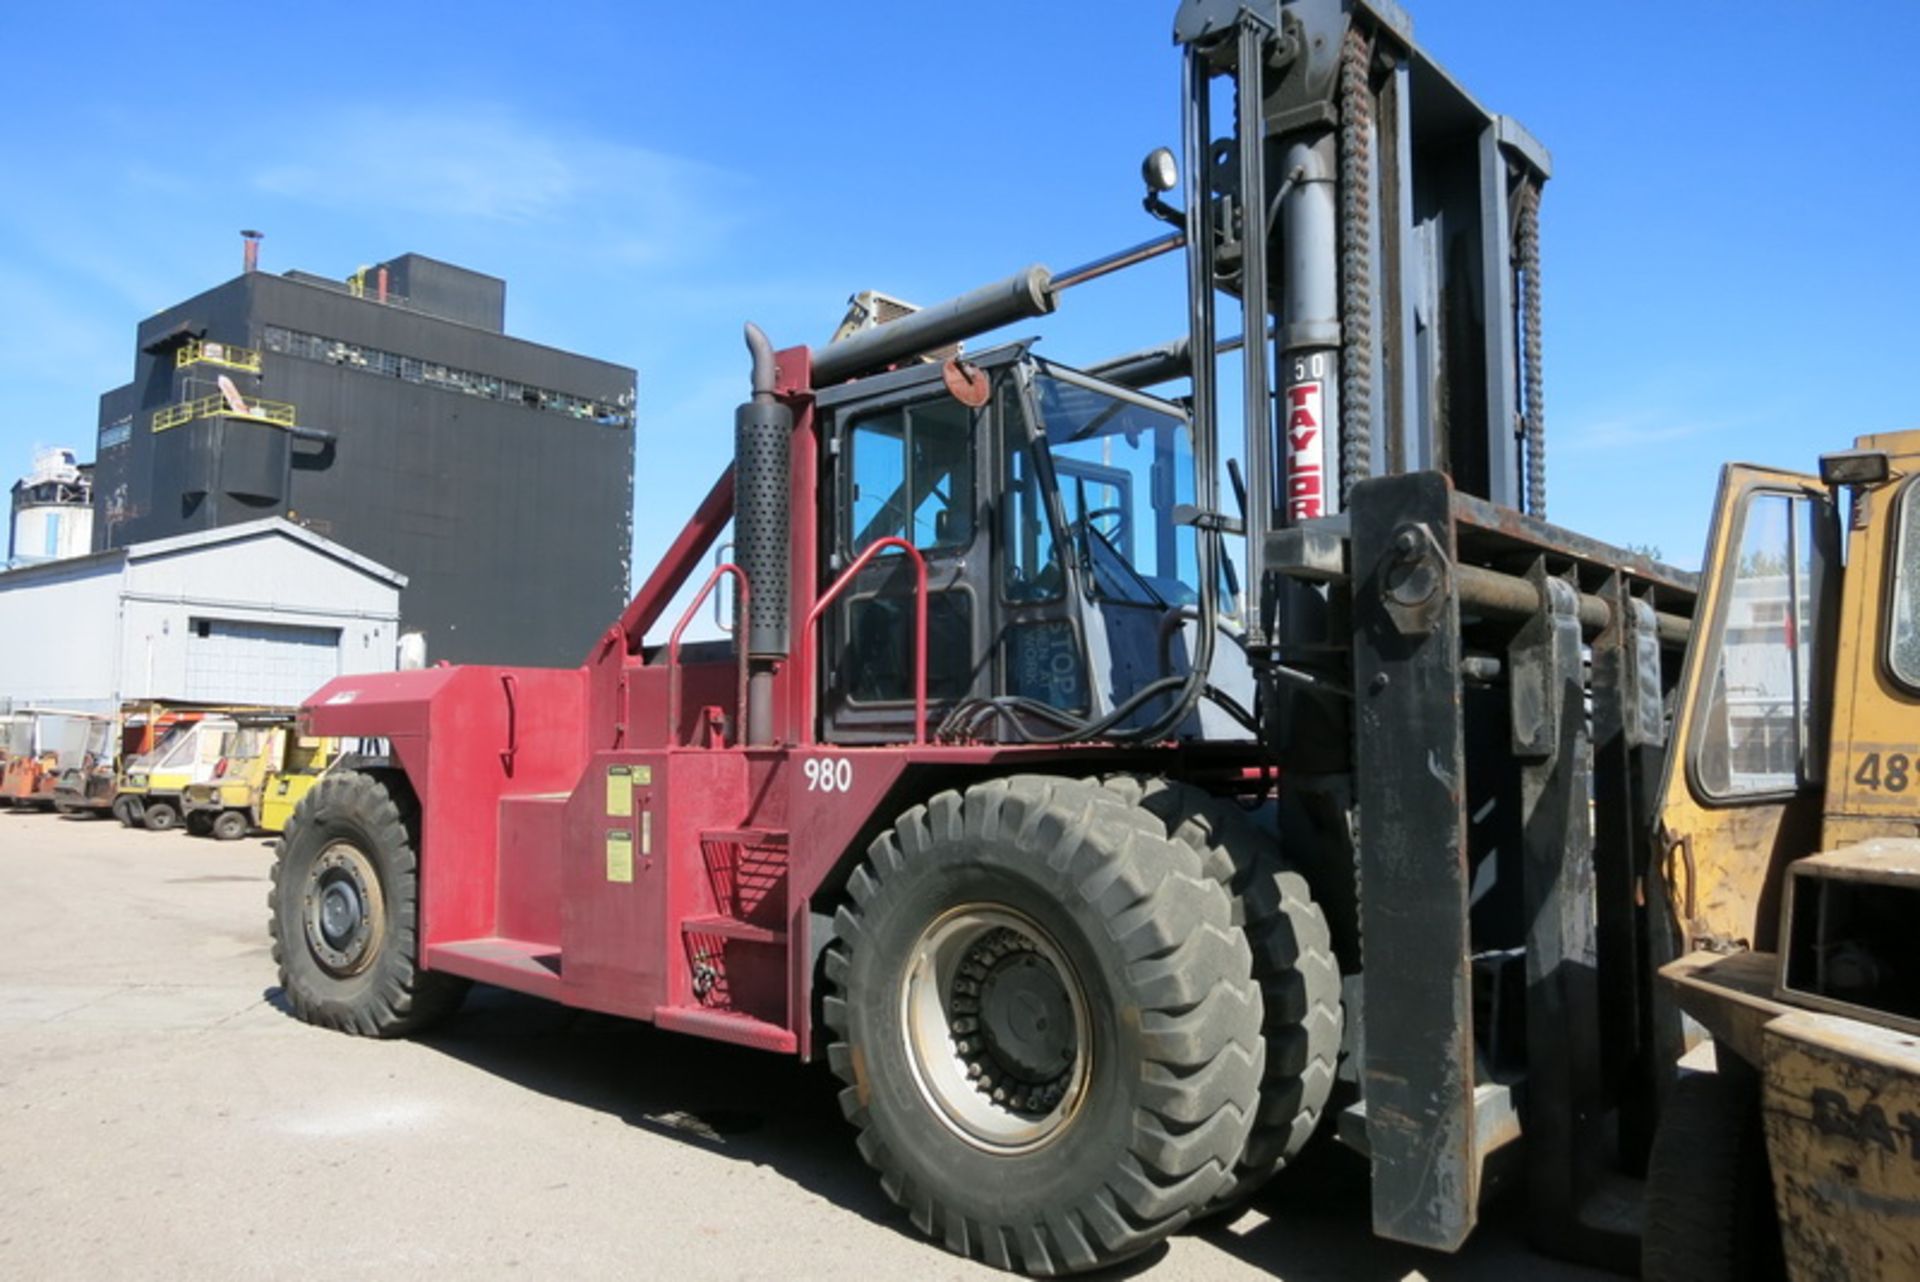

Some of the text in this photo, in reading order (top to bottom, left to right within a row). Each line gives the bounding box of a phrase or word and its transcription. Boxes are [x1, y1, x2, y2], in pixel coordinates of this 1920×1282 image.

[1287, 383, 1321, 520] TAYLOR
[1024, 629, 1040, 685] WORK
[1049, 622, 1076, 694] STOP
[803, 757, 853, 792] 980
[1854, 751, 1920, 793] 48
